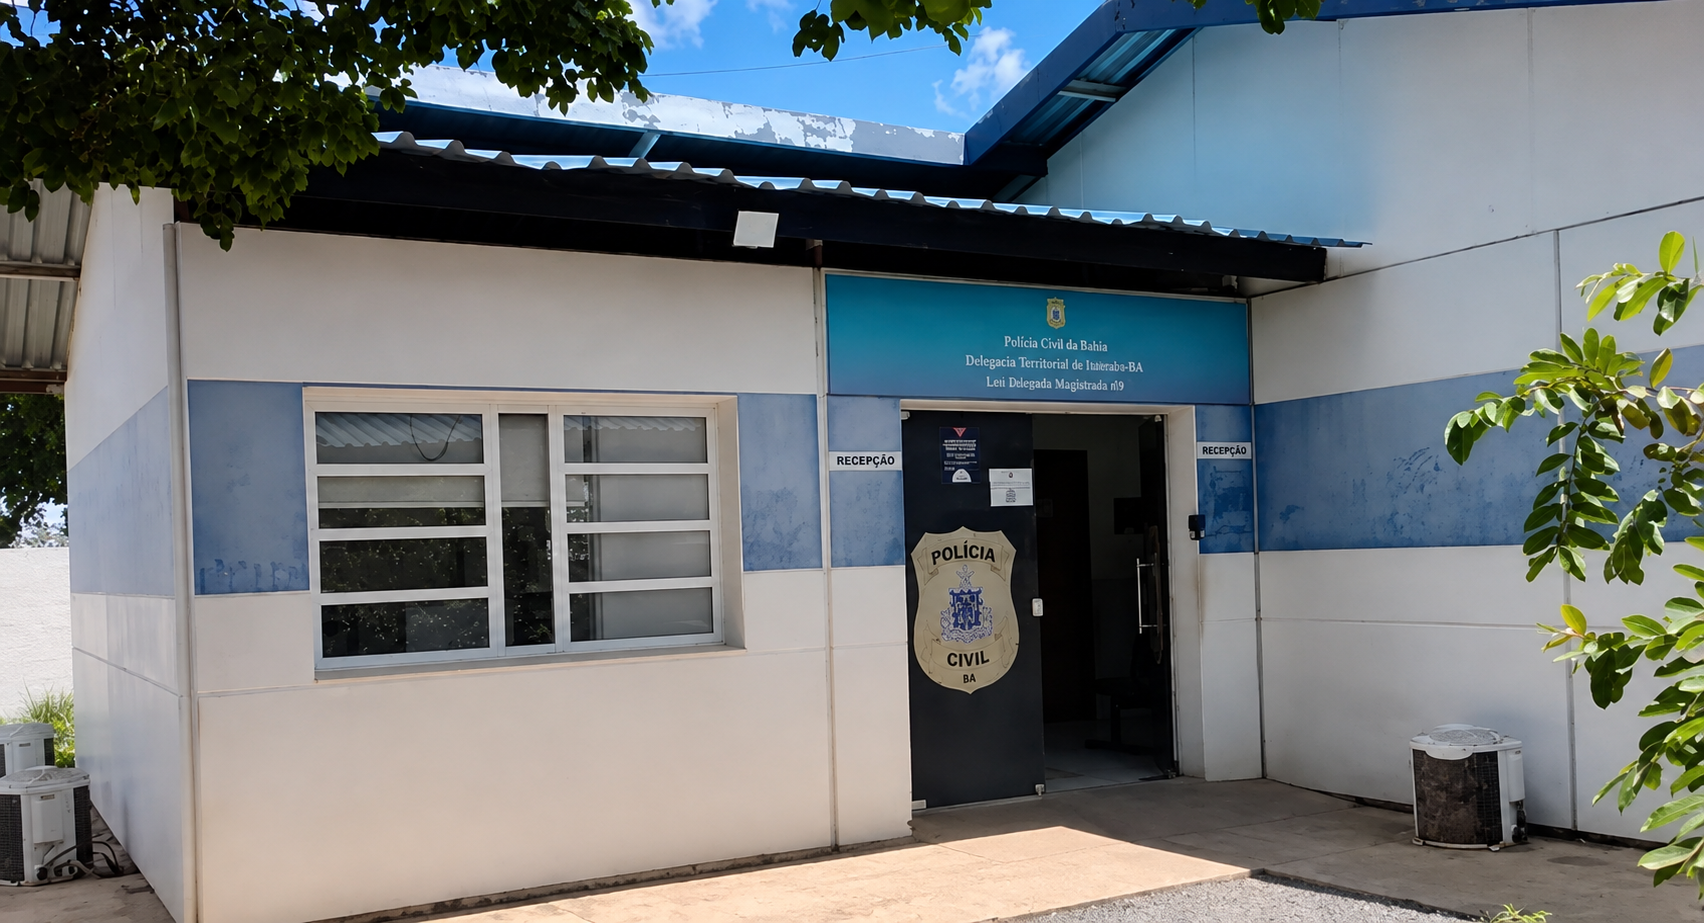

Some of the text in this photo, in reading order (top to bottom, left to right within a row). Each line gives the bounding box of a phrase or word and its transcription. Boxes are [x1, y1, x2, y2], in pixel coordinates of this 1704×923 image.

[1004, 335, 1108, 352] Polícia Civil da Bahia
[965, 354, 1016, 370] Delegacia
[1018, 356, 1069, 370] Territorial
[1071, 359, 1083, 371] de
[1009, 377, 1052, 391] Delegada
[1055, 378, 1108, 393] Magistrada
[836, 453, 895, 469] RECEPÇÃO
[931, 540, 996, 565] POLÍCIA
[947, 650, 990, 667] CIVIL
[962, 673, 977, 684] BA
